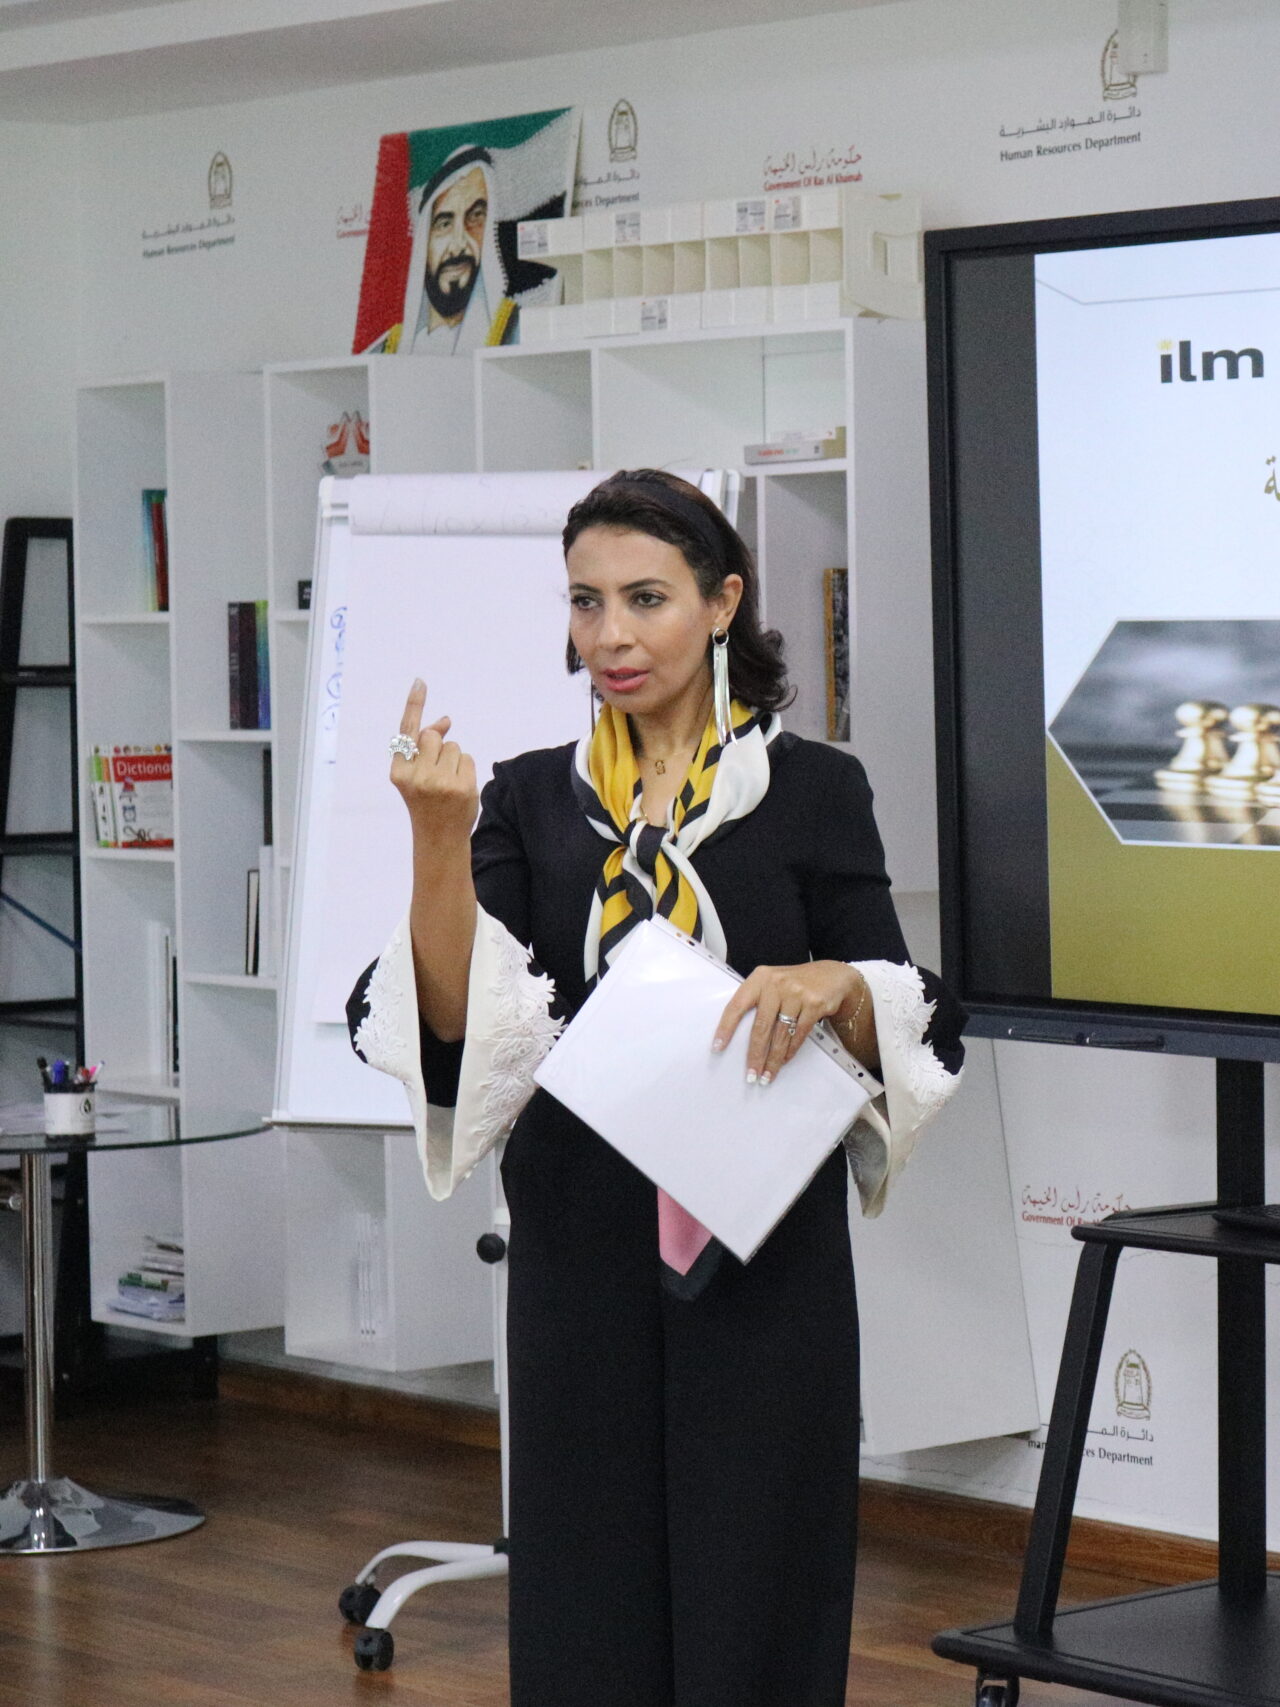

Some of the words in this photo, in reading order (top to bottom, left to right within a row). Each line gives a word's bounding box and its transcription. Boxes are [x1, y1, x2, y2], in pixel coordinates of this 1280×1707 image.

[1000, 148, 1033, 162] Human
[1036, 141, 1081, 157] Resources
[1085, 131, 1141, 151] Department
[764, 180, 801, 192] Government
[836, 172, 863, 184] Khaimah
[1157, 339, 1264, 384] ilm
[116, 759, 171, 777] Dictiona
[1022, 1211, 1064, 1226] Government
[1098, 1447, 1153, 1466] Department
